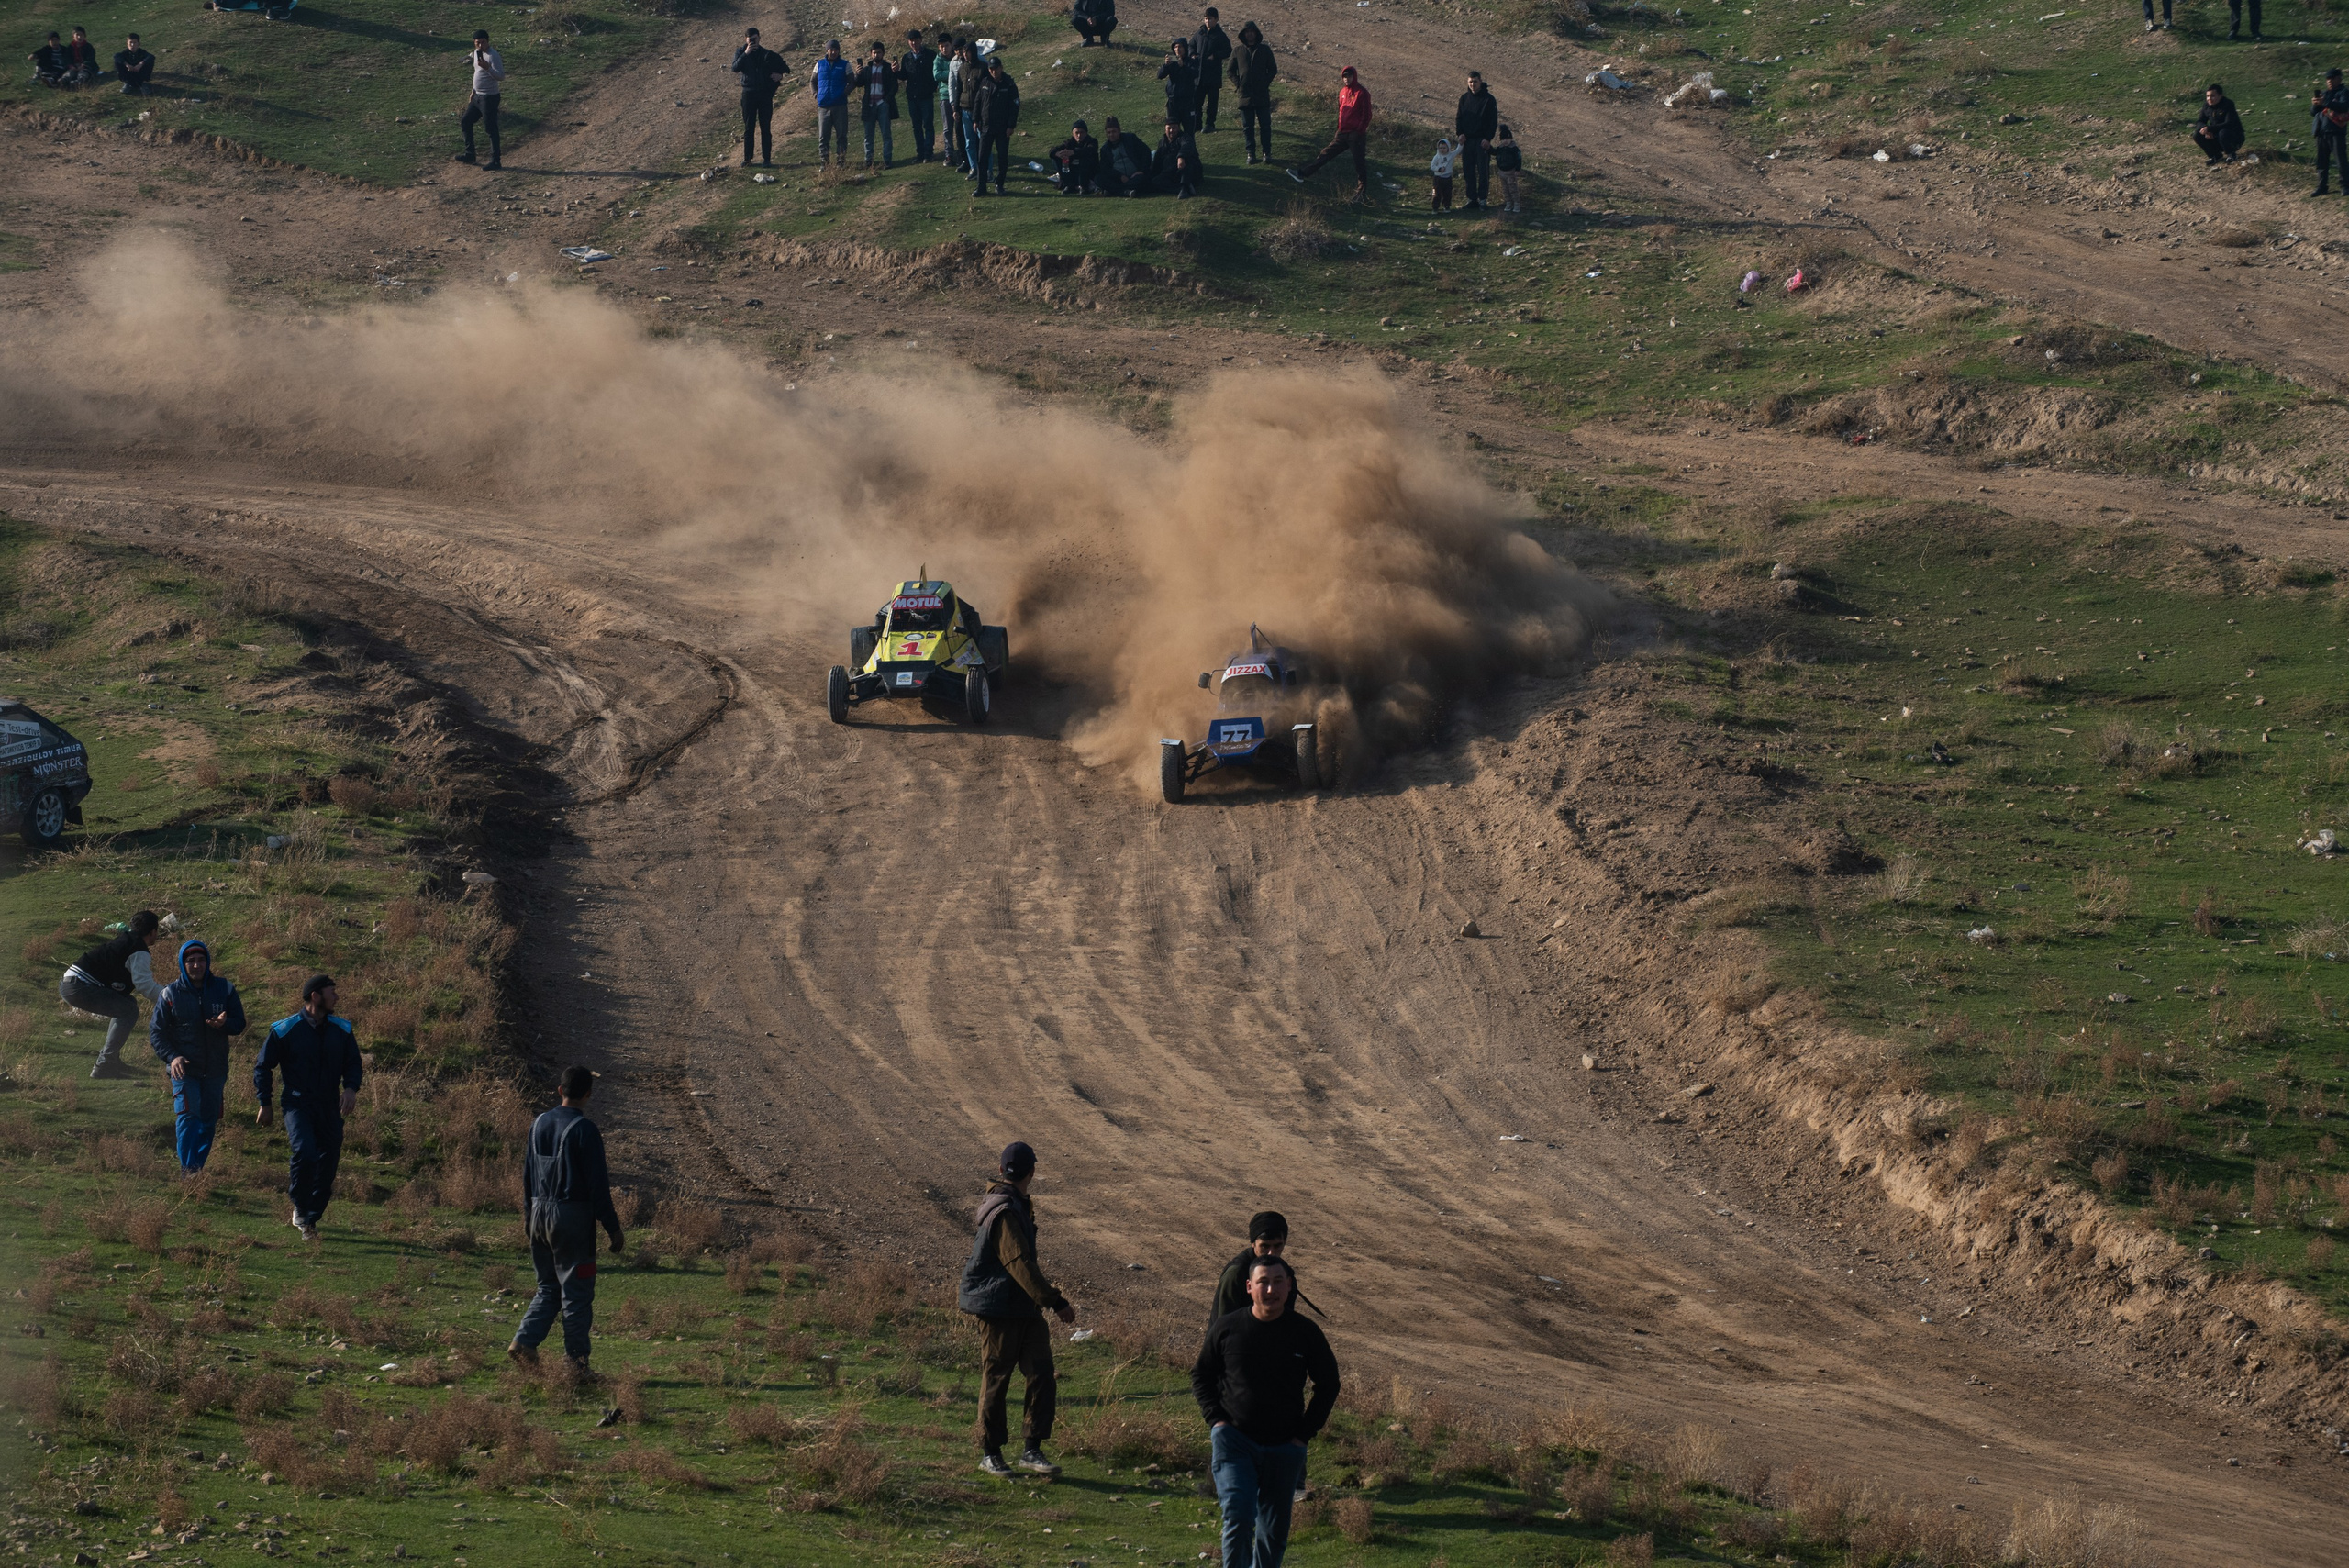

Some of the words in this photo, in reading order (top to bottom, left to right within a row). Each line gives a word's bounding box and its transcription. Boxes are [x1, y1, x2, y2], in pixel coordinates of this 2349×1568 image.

[894, 597, 941, 607] MOTUL
[897, 641, 923, 656] 1
[1228, 665, 1266, 676] JIZZAX
[7, 723, 39, 735] Test-drive
[1223, 730, 1250, 742] 77
[33, 756, 83, 776] MONSTER
